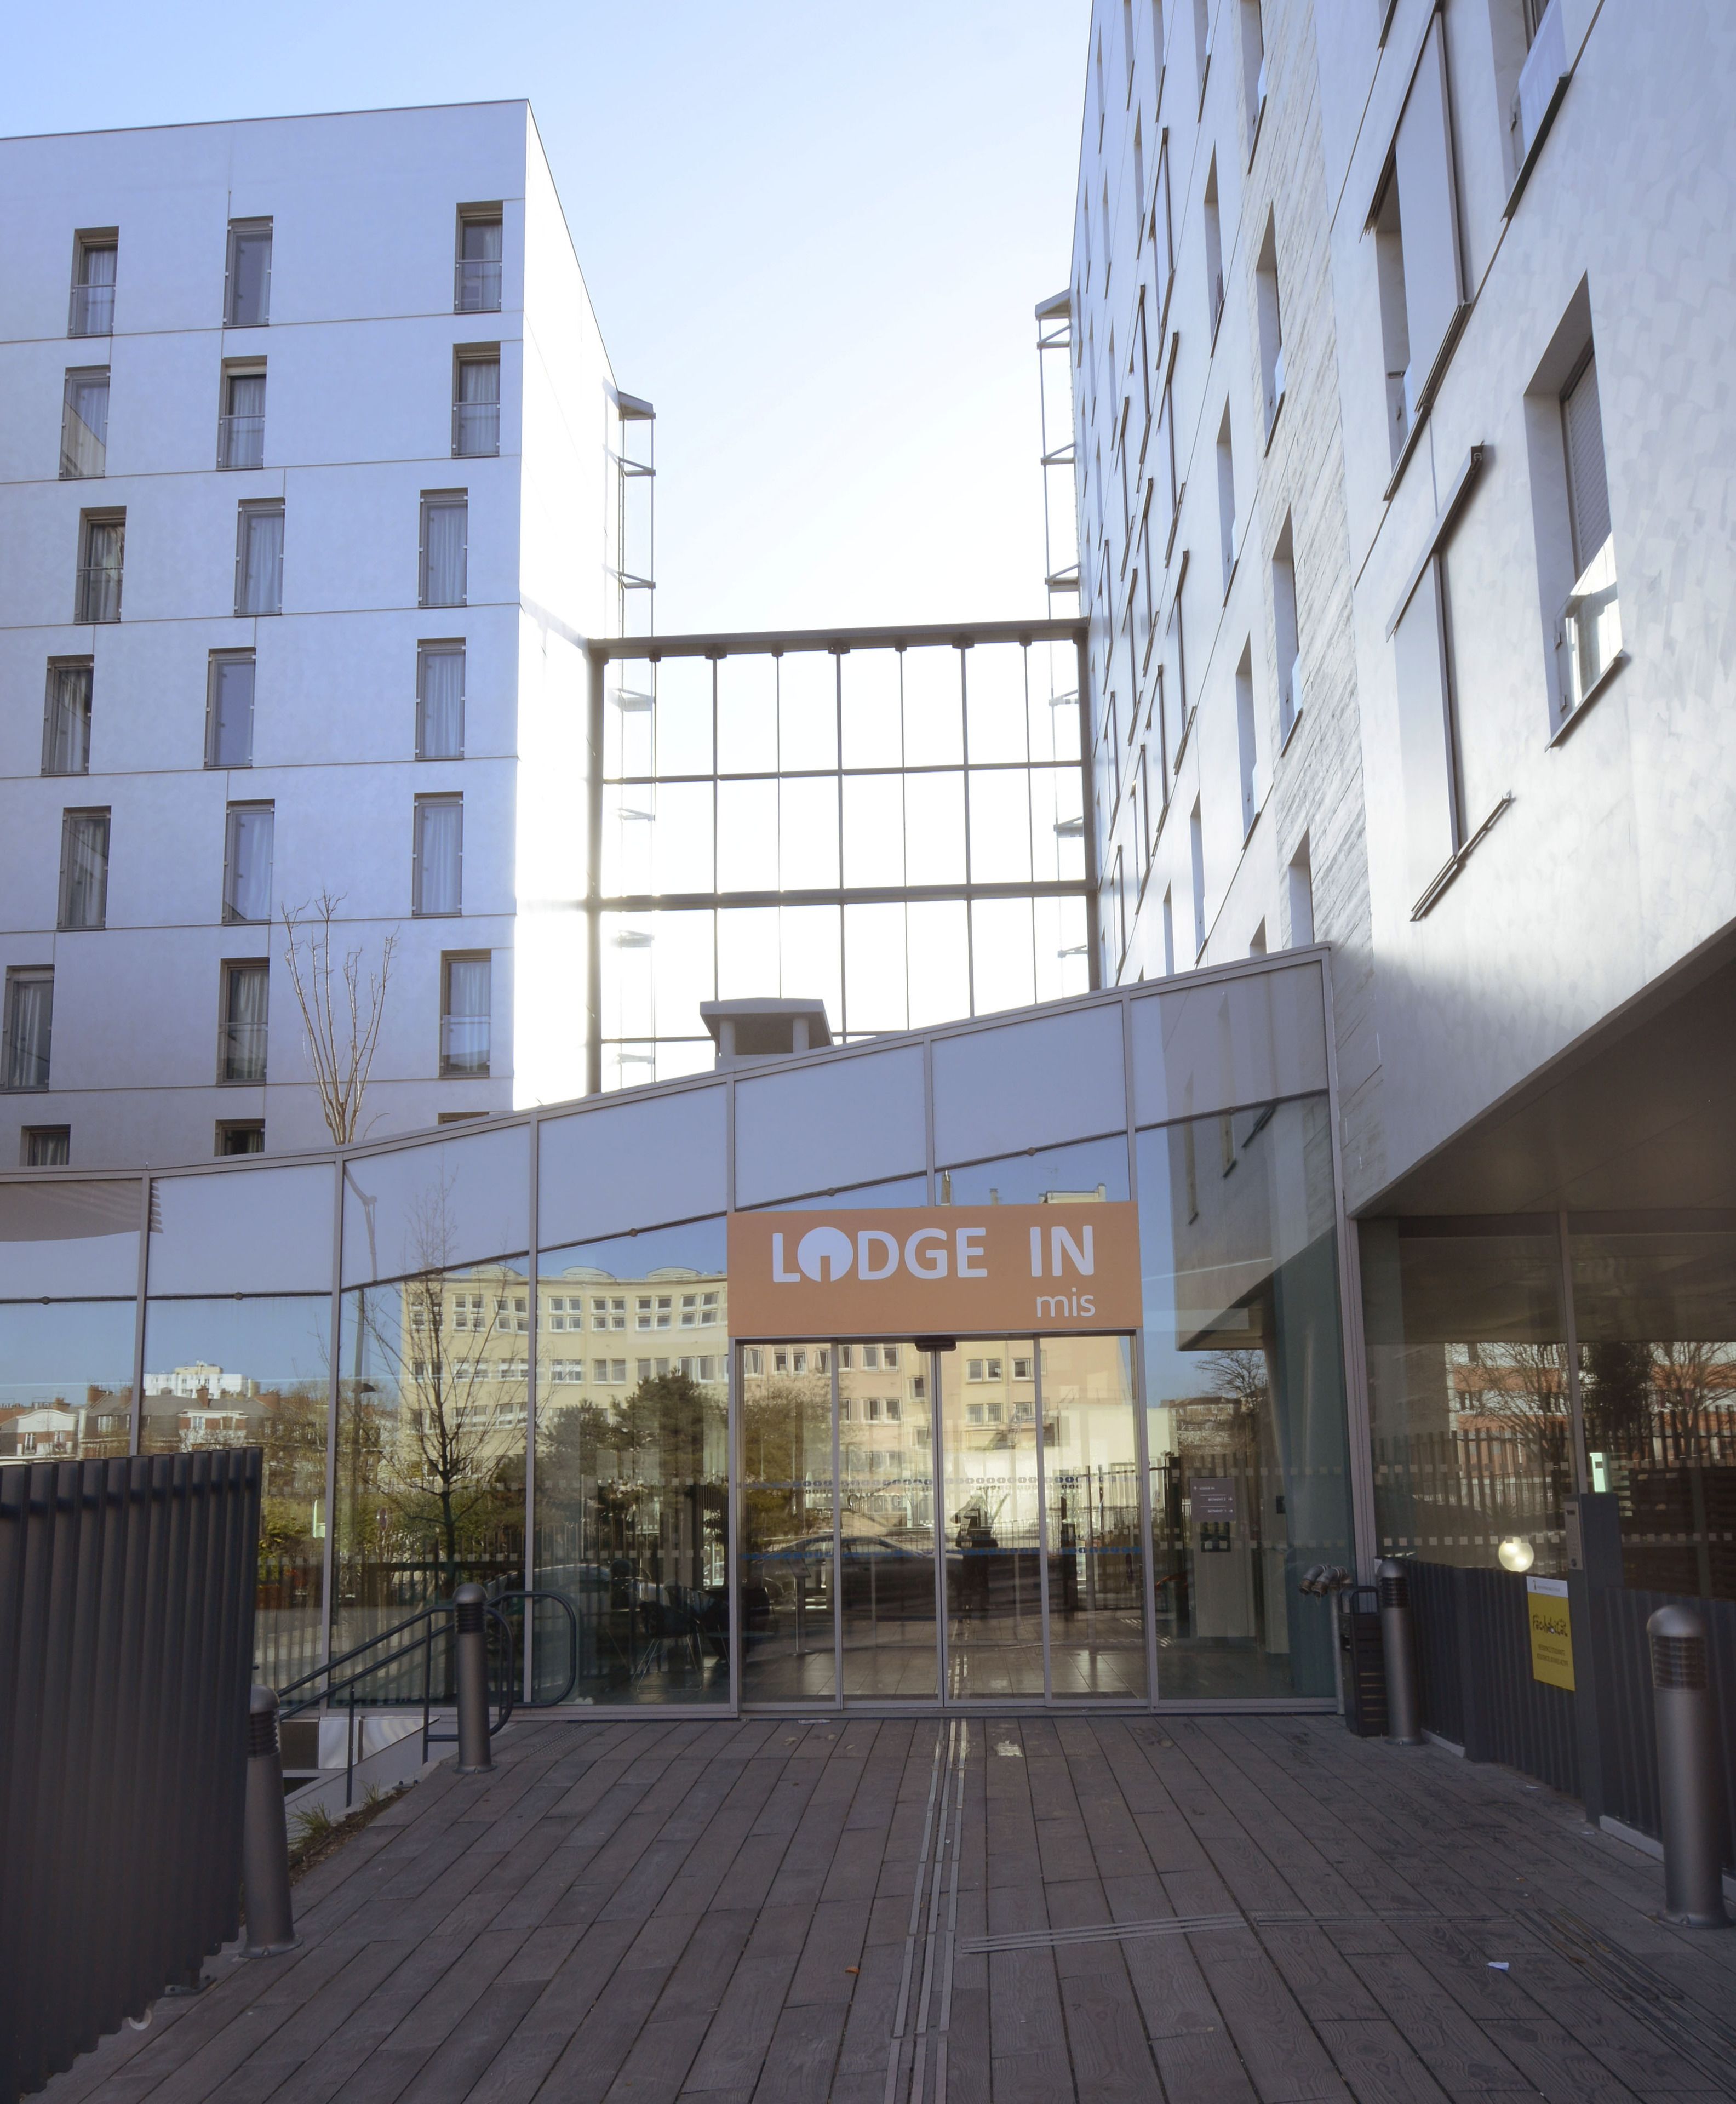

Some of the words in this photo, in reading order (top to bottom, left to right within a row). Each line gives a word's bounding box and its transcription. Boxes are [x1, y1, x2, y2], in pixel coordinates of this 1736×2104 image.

[772, 1226, 987, 1283] LODGE
[1030, 1225, 1095, 1277] IN
[1036, 1288, 1096, 1318] mis
